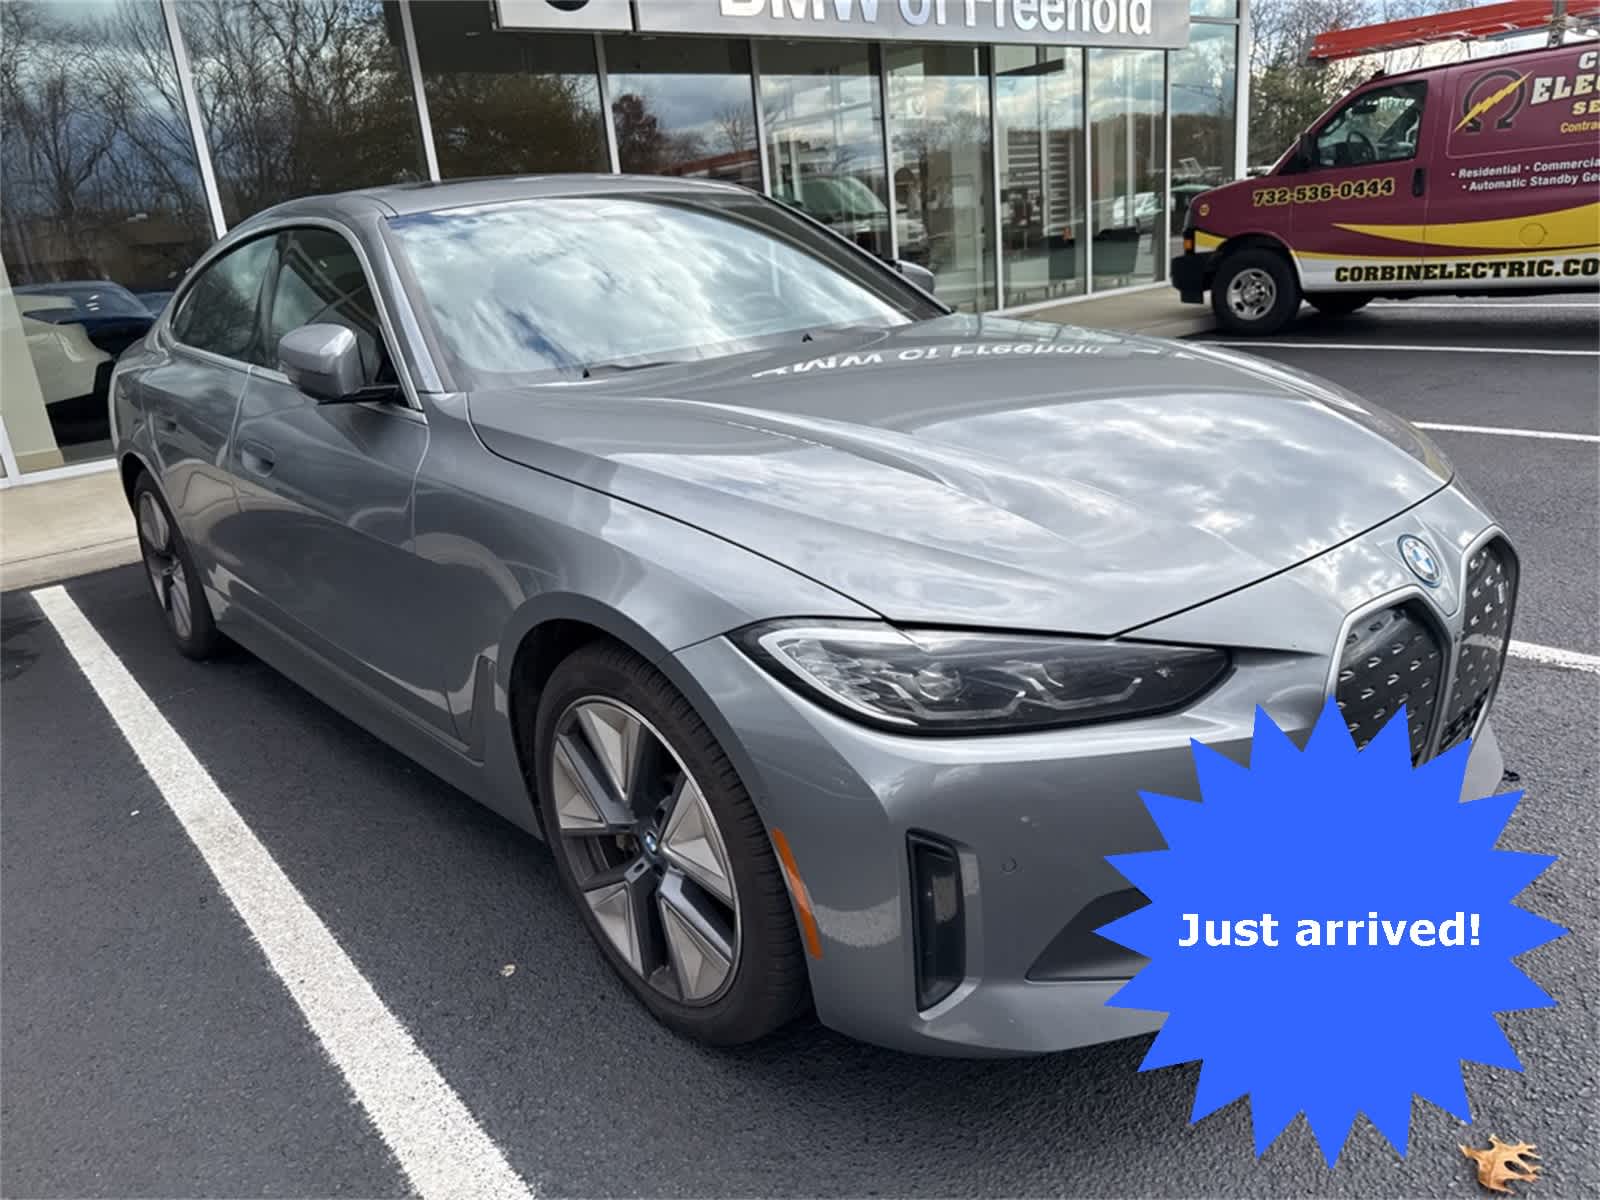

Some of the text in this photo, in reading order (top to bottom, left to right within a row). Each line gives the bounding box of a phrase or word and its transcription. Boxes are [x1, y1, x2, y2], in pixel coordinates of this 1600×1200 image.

[1578, 51, 1600, 70] C
[1530, 74, 1600, 105] ELE
[1560, 121, 1600, 134] Contra
[1458, 164, 1521, 179] Residential
[1469, 171, 1600, 192] Automatic Standby Ge
[1253, 177, 1396, 207] 732-536-0444
[1334, 257, 1599, 283] CORBINELECTRIC.CO
